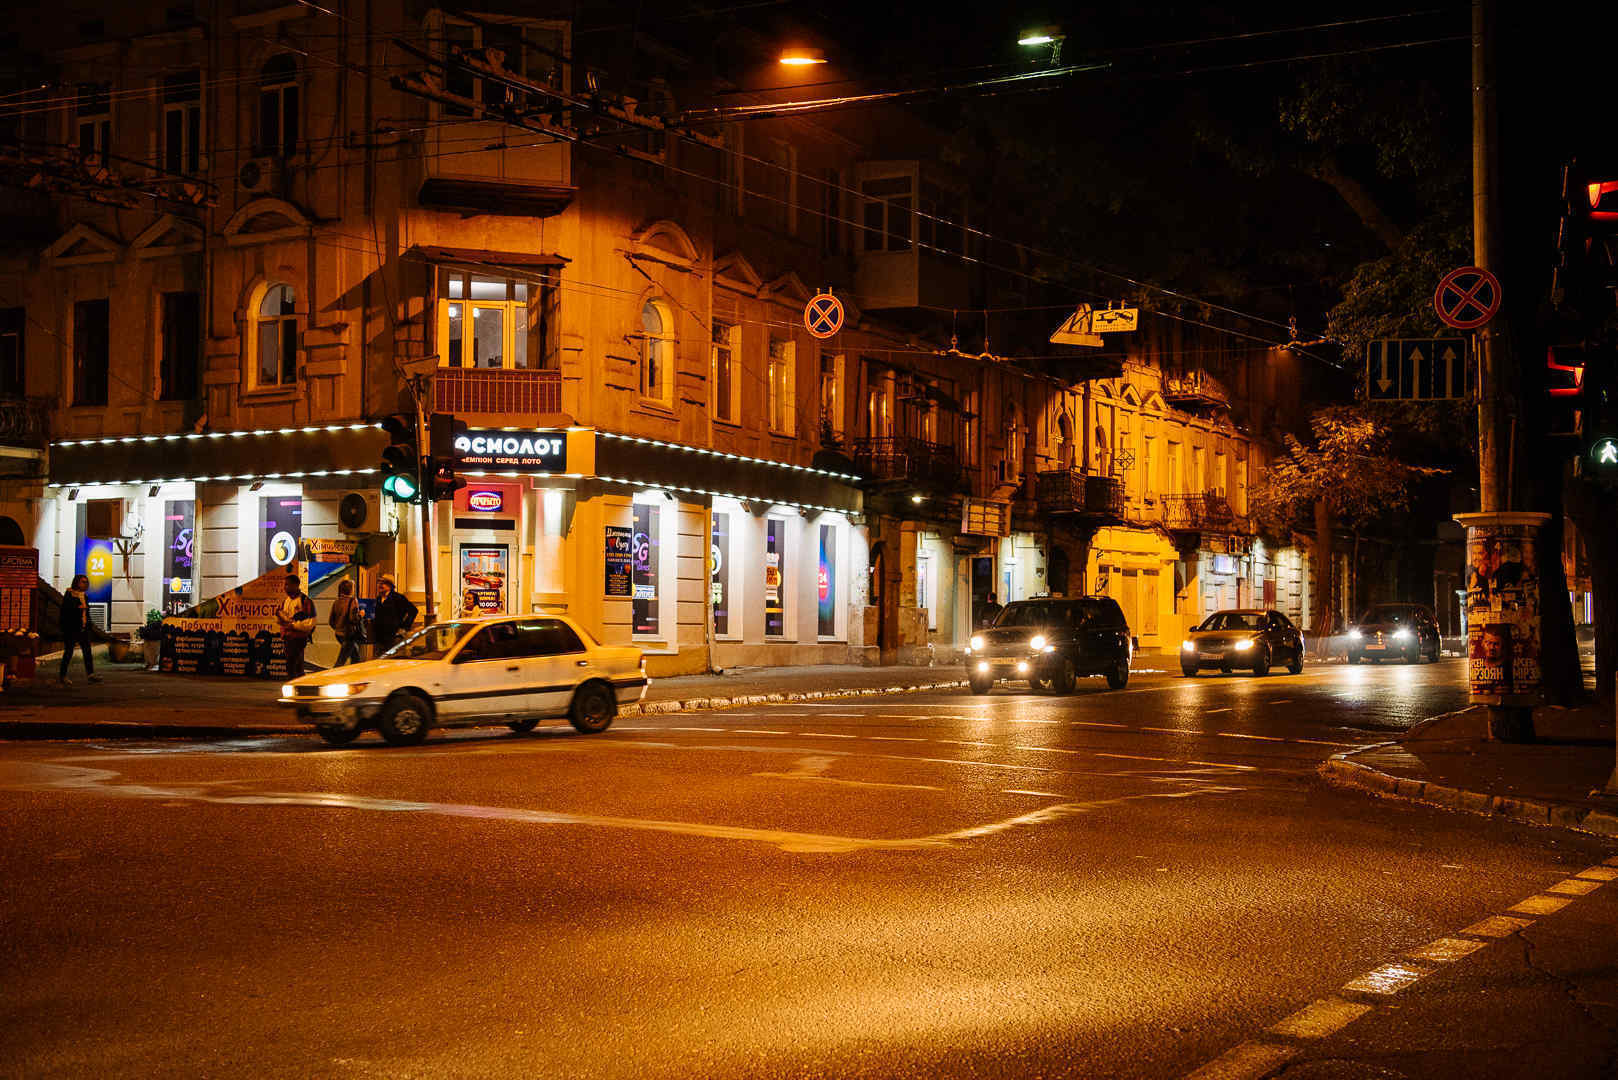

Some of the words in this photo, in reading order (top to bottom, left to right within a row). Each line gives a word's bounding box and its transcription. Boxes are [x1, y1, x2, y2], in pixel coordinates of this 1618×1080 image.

[454, 436, 563, 456] ОСМОЛОТ
[461, 456, 493, 464] ЕМПІОН
[495, 456, 519, 465] СЕРЕД
[91, 558, 105, 570] 24
[217, 598, 285, 617] Хімчистк
[181, 619, 223, 631] Побутові
[235, 622, 273, 632] послуги
